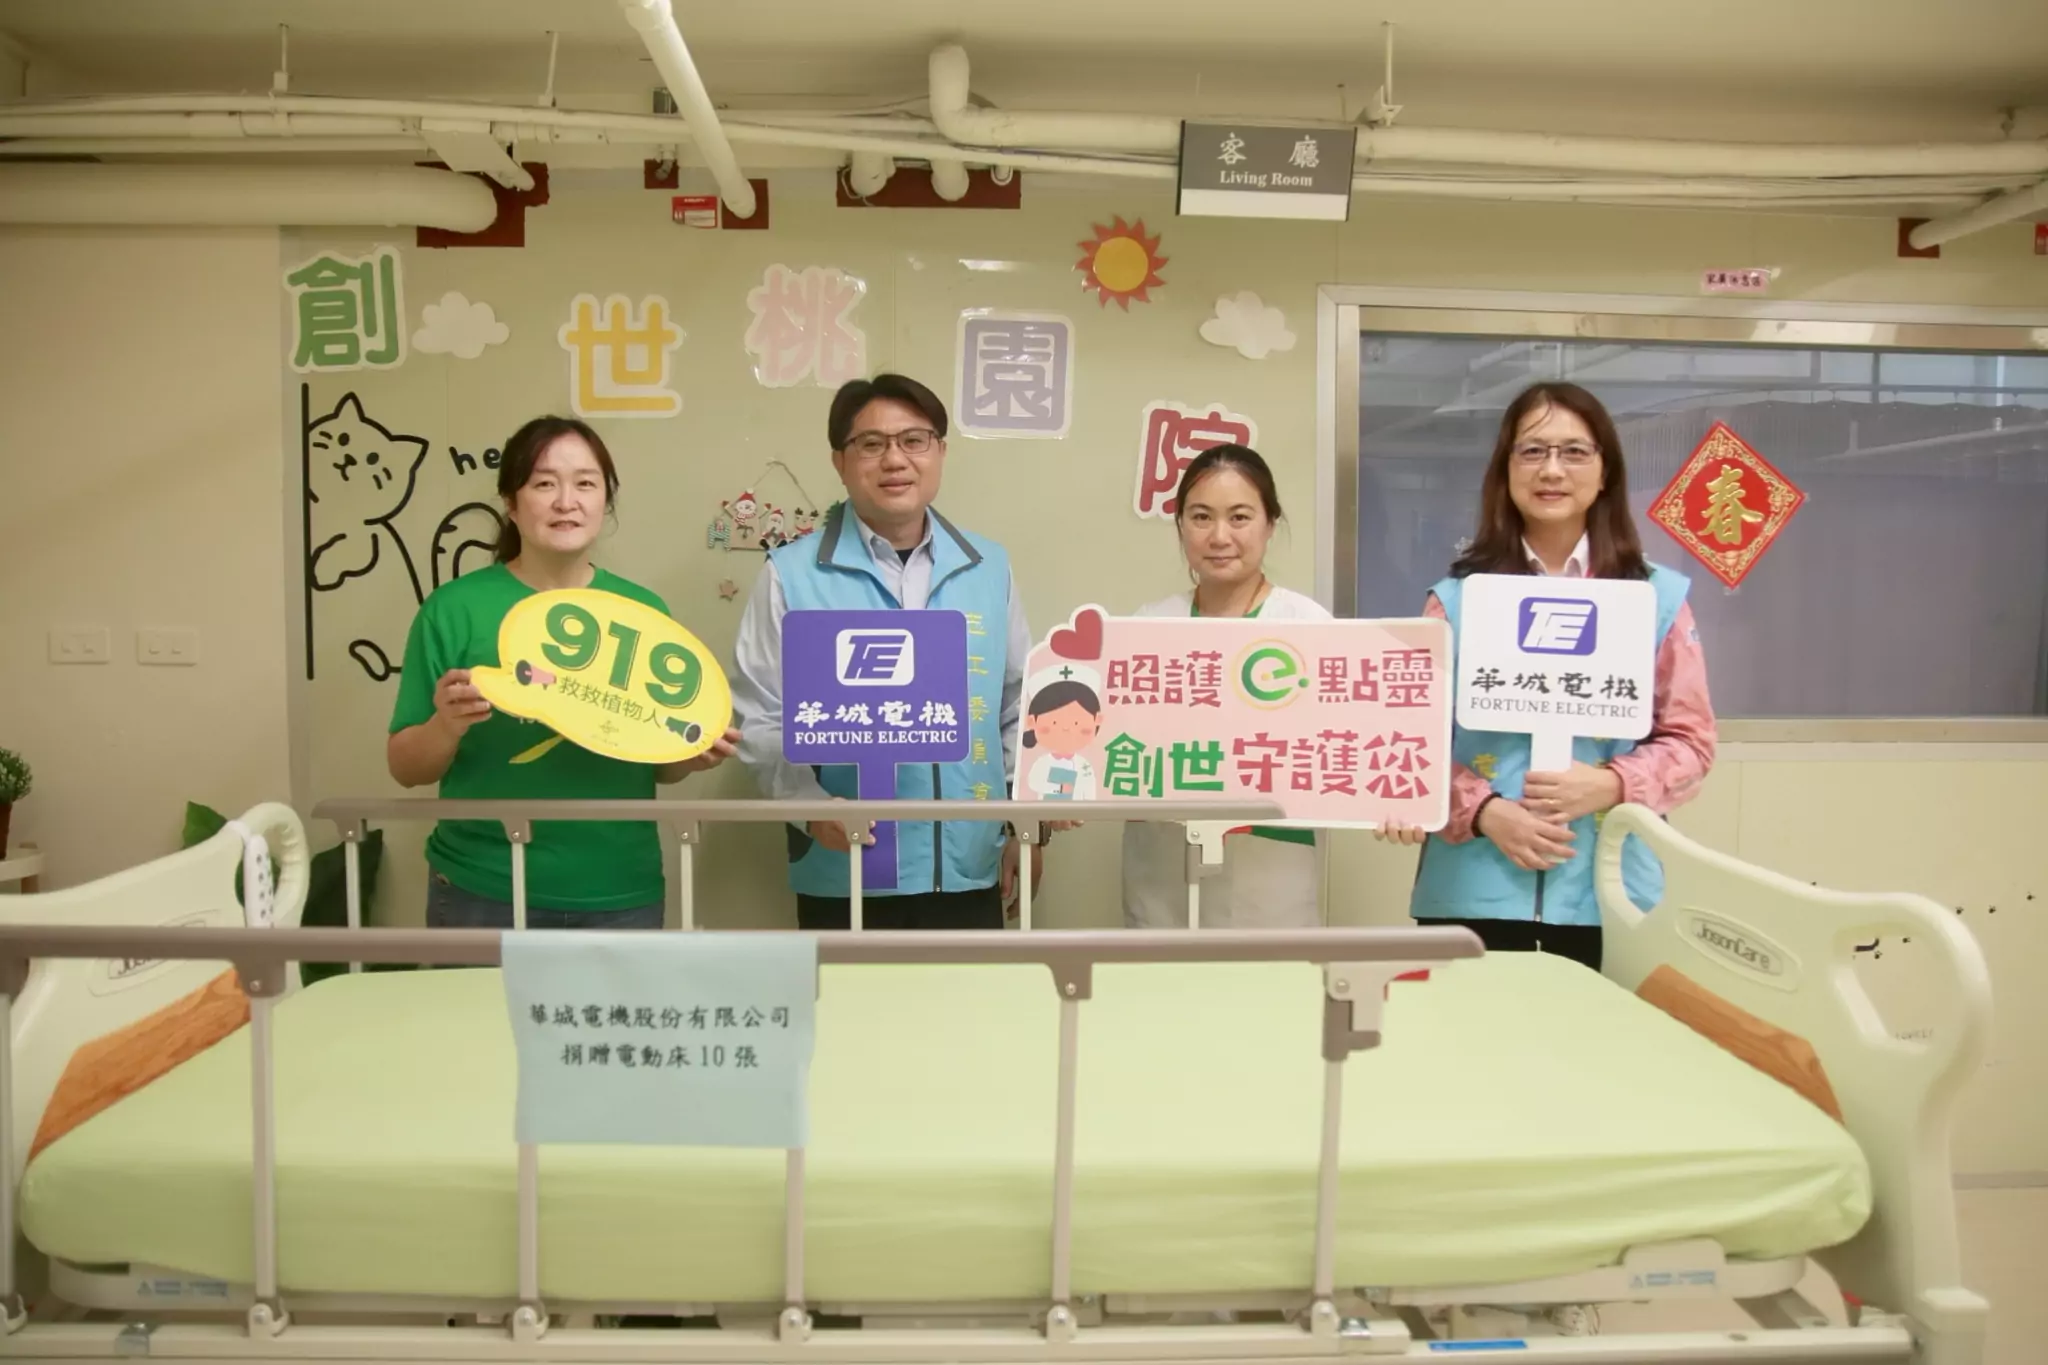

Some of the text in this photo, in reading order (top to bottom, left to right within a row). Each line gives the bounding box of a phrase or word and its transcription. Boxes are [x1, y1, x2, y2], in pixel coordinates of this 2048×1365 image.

[1217, 132, 1320, 168] 客廳
[1219, 170, 1313, 187] Living Room
[1697, 464, 1765, 545] 春
[541, 602, 703, 710] 919
[1471, 667, 1640, 700] 華城電機
[558, 675, 662, 729] 救救植物人
[794, 700, 958, 728] 華城電機
[1470, 696, 1639, 719] FORTUNE ELECTRIC
[795, 730, 958, 745] FORTUNE ELECTRIC
[1103, 729, 1432, 800] 創世守護您
[1697, 923, 1771, 970] JosonCare
[529, 1003, 791, 1029] 華城電機股份有限公司
[561, 1043, 759, 1068] 捐贈電動床 10 張
